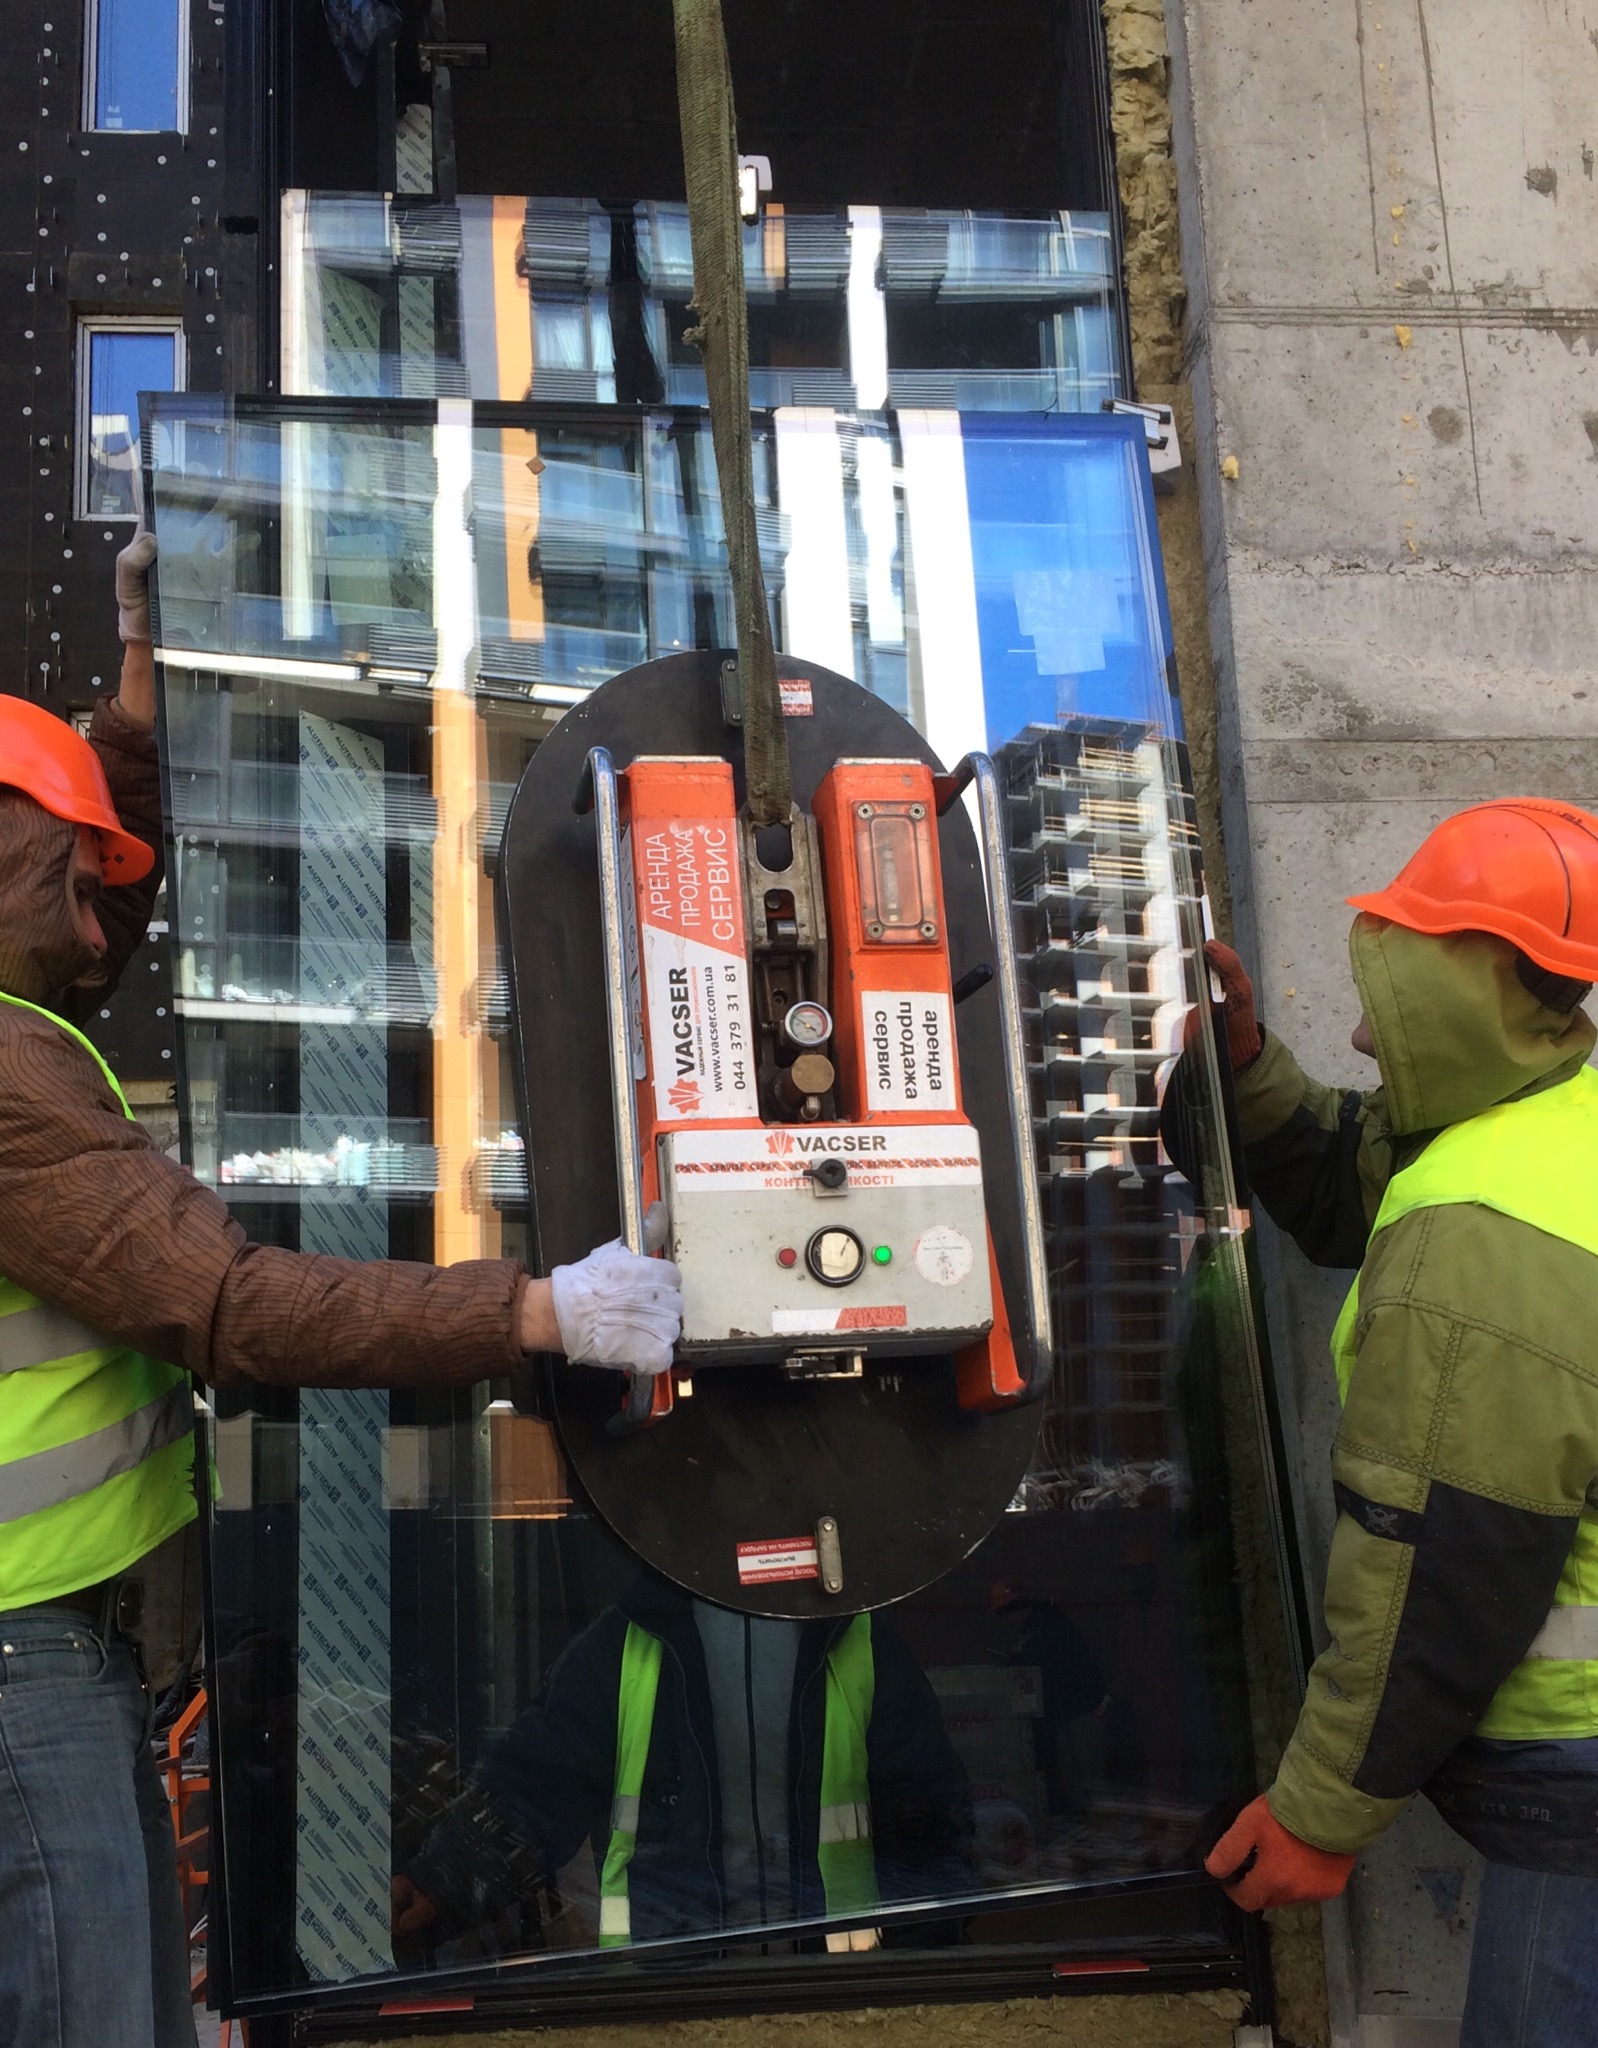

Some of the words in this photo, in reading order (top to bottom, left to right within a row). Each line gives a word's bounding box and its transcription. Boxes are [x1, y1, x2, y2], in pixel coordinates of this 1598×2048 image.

[306, 725, 331, 759] ALUTECH
[335, 735, 359, 770] ALUTECH
[306, 864, 331, 898] ALUTECH
[336, 874, 359, 906] ALUTECH
[645, 832, 673, 920] АРЕНДА
[674, 828, 702, 927] ПРОДАЖА
[704, 828, 735, 941] СЕРВИС
[723, 965, 736, 982] 81
[726, 994, 739, 1011] 31
[668, 966, 696, 1077] VACSER
[704, 966, 723, 1092] www.vacser.com.ua
[729, 1021, 743, 1050] 379
[872, 1010, 891, 1090] сервис
[896, 1001, 918, 1099] продажа
[922, 1010, 942, 1091] аренда
[732, 1060, 746, 1090] 044
[797, 1134, 887, 1152] VACSER
[764, 1177, 811, 1188] КОНТР
[343, 1428, 368, 1460] ALUTECH
[307, 1459, 332, 1491] ALUTECH
[337, 1461, 361, 1493] ALUTECH
[312, 1585, 339, 1617] ALUTECH
[343, 1585, 369, 1617] ALUTECH
[306, 1619, 332, 1651] ALUTECH
[337, 1618, 362, 1650] ALUTECH
[311, 1747, 338, 1780] ALUTECH
[342, 1746, 369, 1778] ALUTECH
[304, 1784, 332, 1815] ALUTECH
[336, 1782, 362, 1813] ALUTECH
[309, 1920, 337, 1951] ALUTECH
[342, 1915, 369, 1946] ALUTECH
